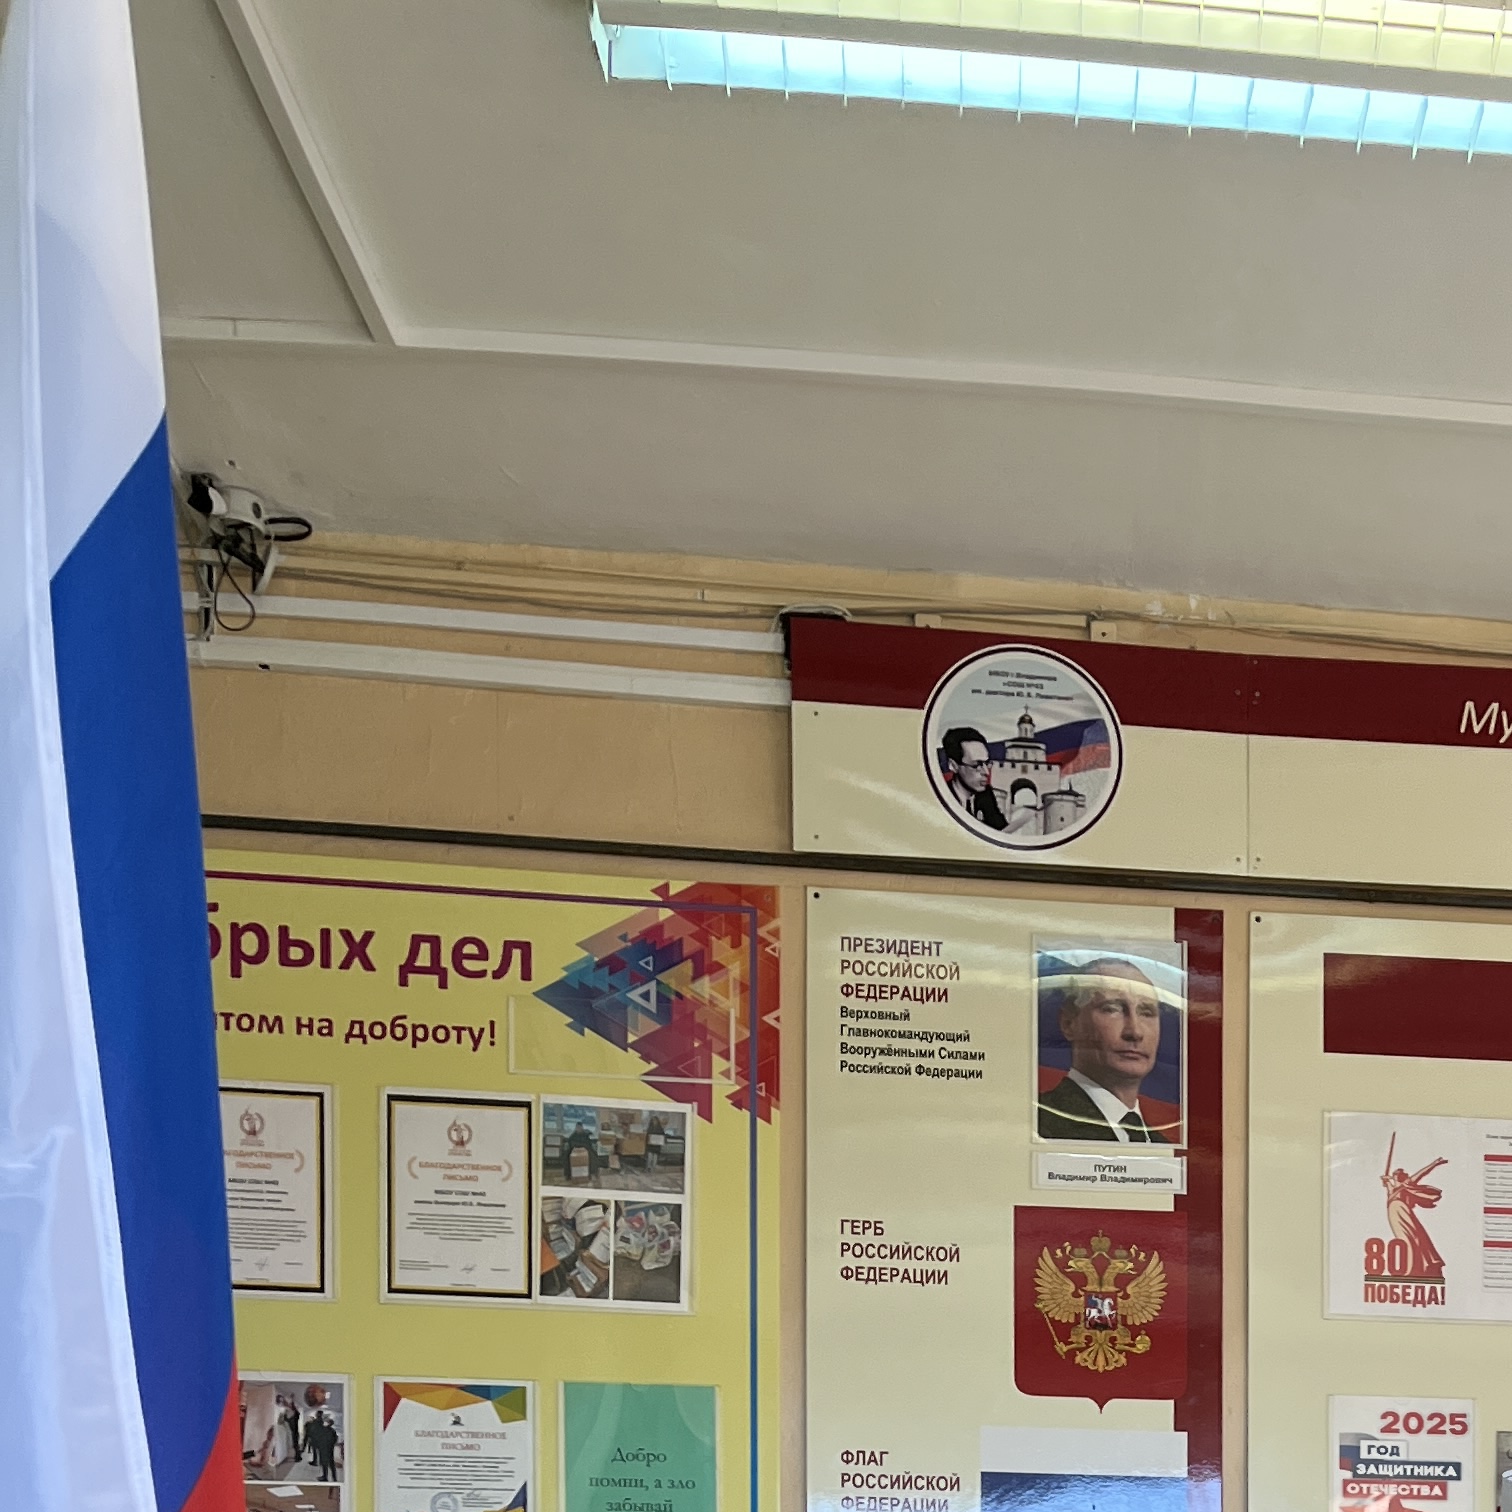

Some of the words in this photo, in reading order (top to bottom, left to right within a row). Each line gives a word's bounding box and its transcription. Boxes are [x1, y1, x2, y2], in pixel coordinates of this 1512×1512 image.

[840, 935, 943, 958] ПРЕЗИДЕНТ
[398, 933, 533, 990] дел
[840, 958, 961, 982] РОССИЙСКОЙ
[840, 983, 949, 1004] ФЕДЕРАЦИИ
[840, 1005, 911, 1022] Верховный
[214, 1011, 284, 1035] том
[296, 1016, 333, 1037] на
[344, 1015, 496, 1052] доброту!
[840, 1024, 970, 1044] Главнокомандующий
[938, 1046, 986, 1062] Силами
[840, 1060, 912, 1077] Российской
[915, 1064, 983, 1080] Федерации
[1048, 1172, 1098, 1183] Владимир
[1094, 1164, 1127, 1174] ПУТИН
[840, 1219, 885, 1237] ГЕРБ
[840, 1241, 961, 1264] РОССИЙСКОЙ
[1364, 1236, 1403, 1277] 80
[840, 1265, 949, 1287] ФЕДЕРАЦИИ
[1363, 1283, 1446, 1308] ПОБЕДА!
[1380, 1411, 1469, 1436] 2025
[611, 1447, 667, 1468] Добро
[840, 1449, 889, 1467] ФЛАГ
[1367, 1444, 1401, 1457] ГОД
[1356, 1463, 1458, 1477] ЗАЩИТНИКА
[589, 1476, 649, 1491] помни,
[653, 1479, 663, 1489] а
[667, 1479, 697, 1490] зло
[840, 1471, 961, 1492] РОССИЙСКОЙ
[1346, 1482, 1443, 1497] ОТЕЧЕСТВА
[605, 1497, 673, 1512] забывай
